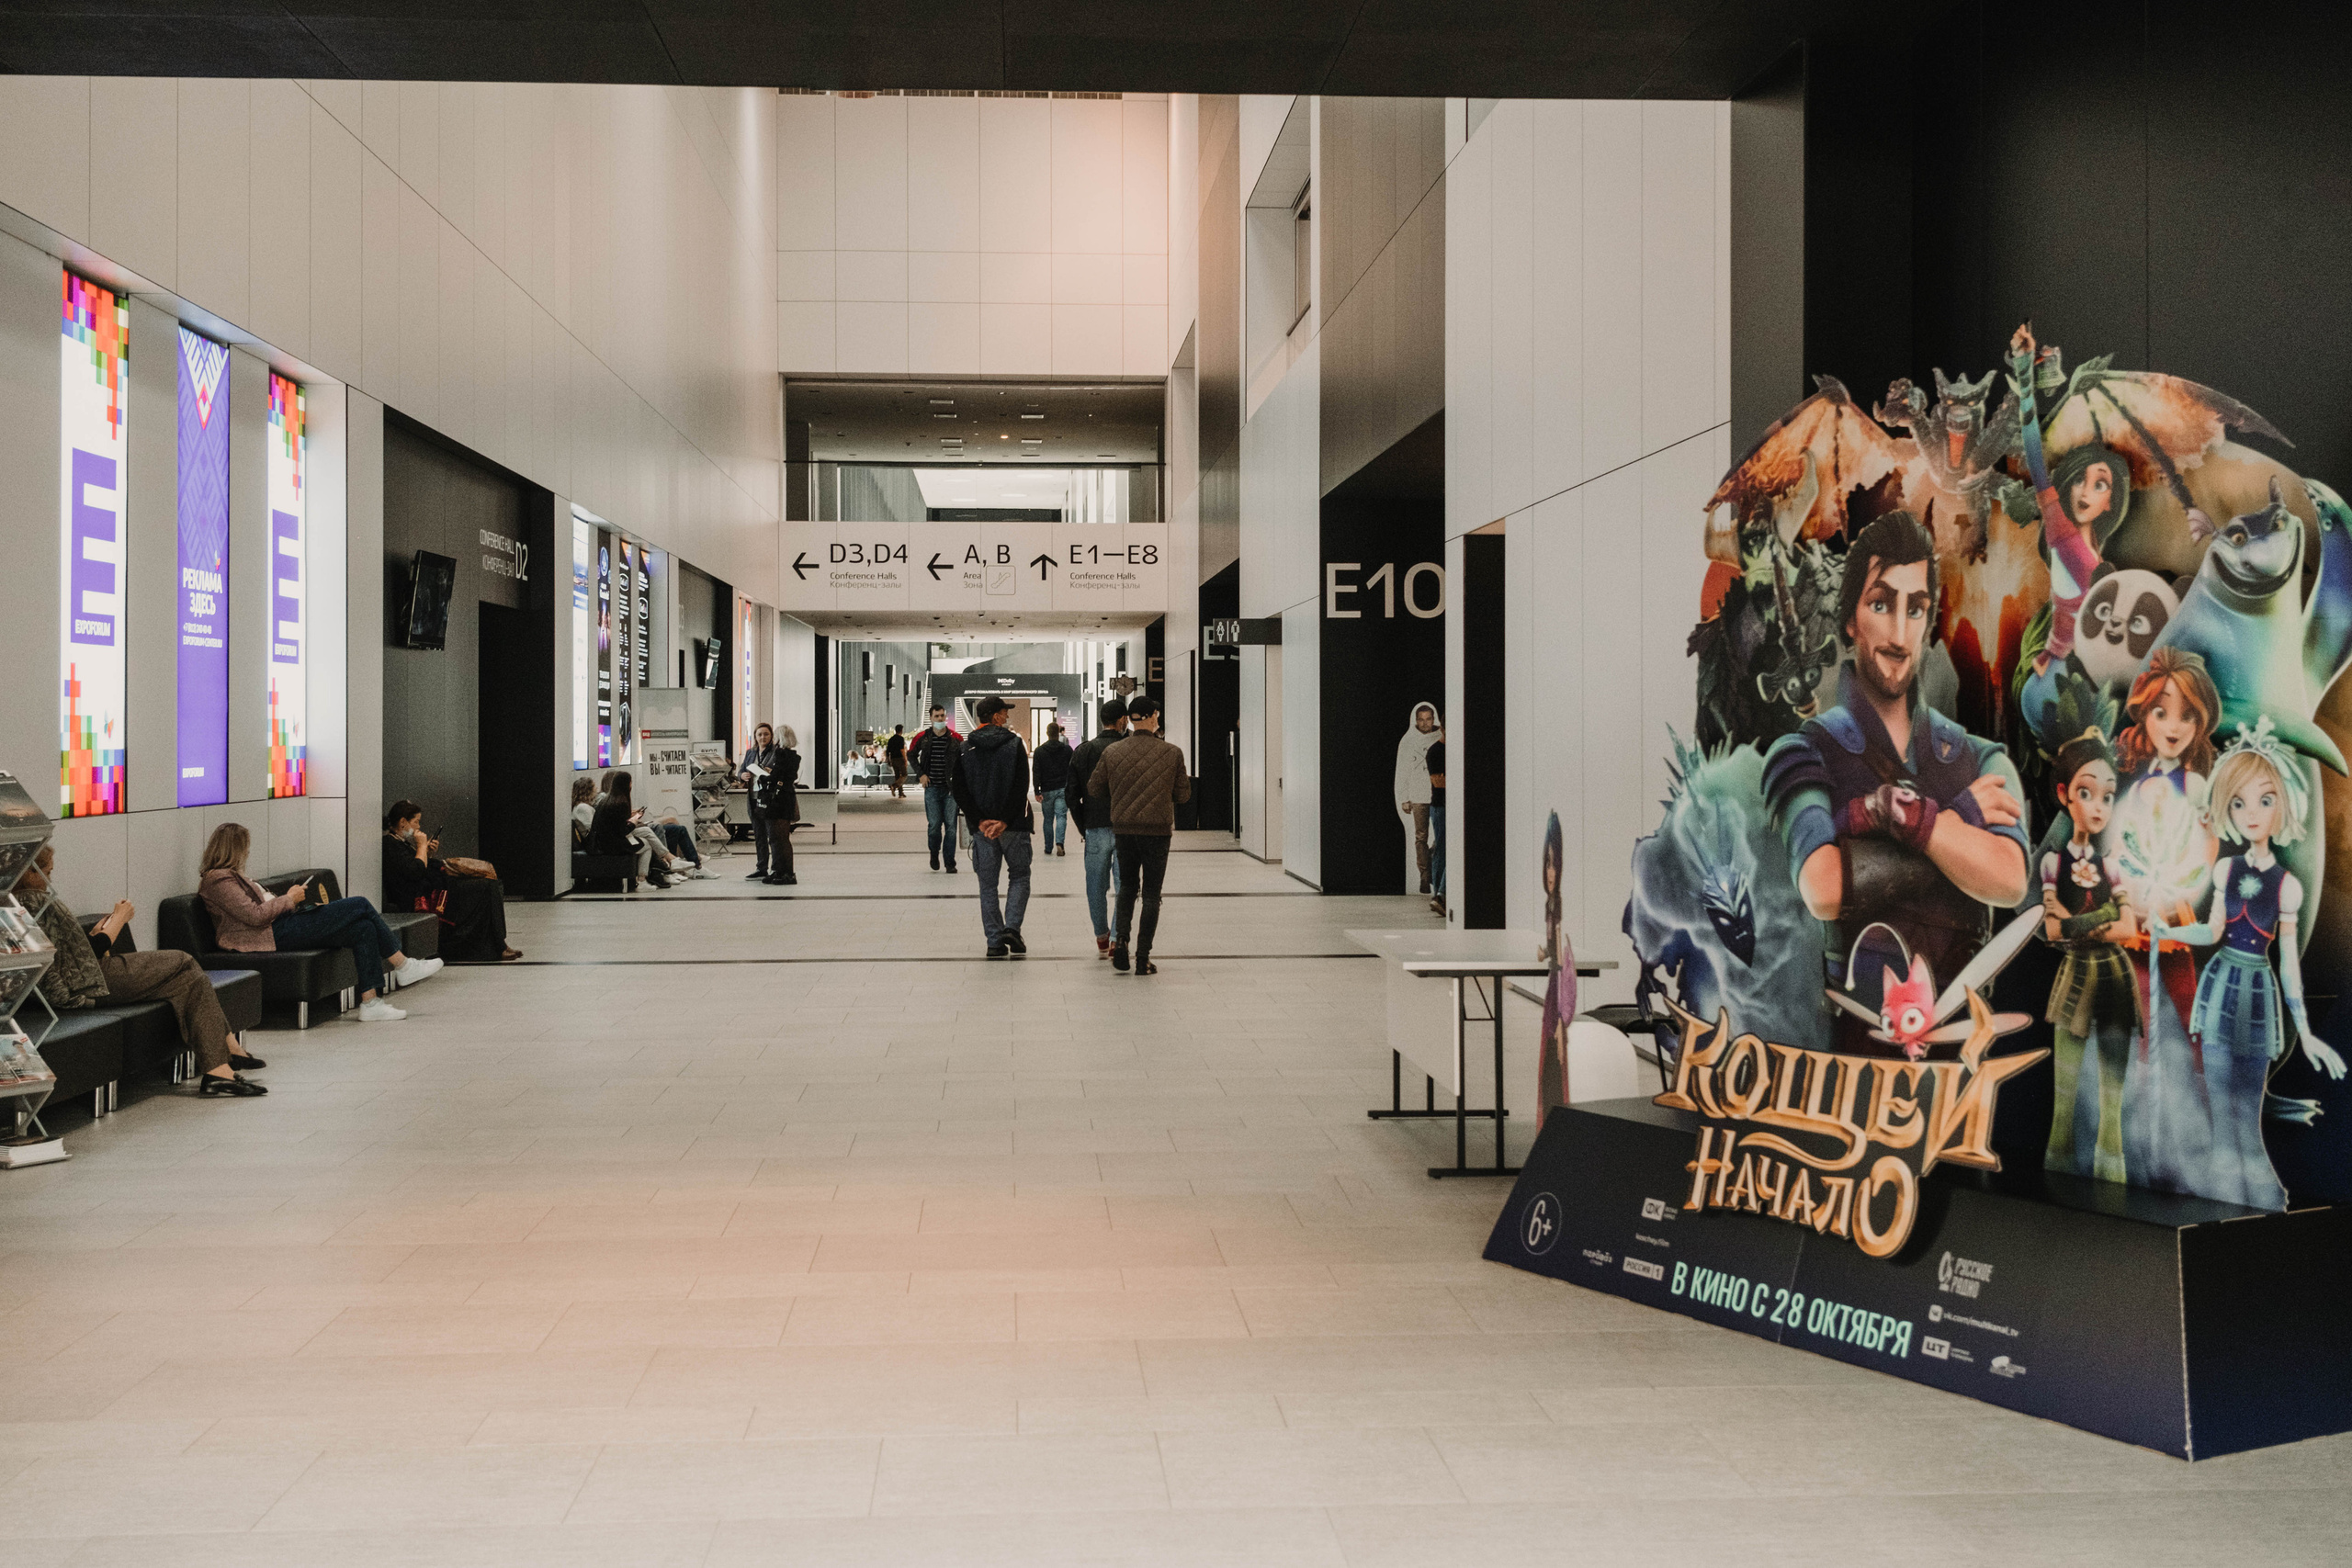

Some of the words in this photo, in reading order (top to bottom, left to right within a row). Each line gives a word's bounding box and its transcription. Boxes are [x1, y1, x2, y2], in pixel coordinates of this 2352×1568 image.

[515, 541, 528, 581] D2
[830, 544, 908, 567] D3,D4
[964, 544, 987, 568] A,
[997, 544, 1011, 564] B
[183, 567, 222, 594] РЕКЛАМА
[830, 571, 876, 580] Conference
[830, 581, 902, 590] Конференц-залы
[963, 571, 981, 580] Area
[963, 581, 983, 589] Зона
[1069, 571, 1114, 580] Conference
[1116, 571, 1136, 580] Halls
[1069, 581, 1141, 590] Конференц-залы
[1326, 561, 1446, 619] E10
[189, 592, 216, 618] ЗДЕСЬ
[661, 750, 686, 762] СЧИТАЕМ
[650, 763, 661, 775] ВЫ
[665, 764, 687, 775] ЧИТАЕТЕ
[1654, 985, 2051, 1177] КОЩЕЙ
[1683, 1125, 1918, 1258] НАЧАЛО
[1529, 1200, 1553, 1247] 6+
[1625, 1258, 1651, 1273] РОССИЯ
[1671, 1261, 1689, 1295] В
[1690, 1266, 1749, 1313] КИНО
[1751, 1283, 1770, 1317] С
[1770, 1289, 1805, 1328] 28
[1807, 1298, 1914, 1359] ОКТЯБРЯ
